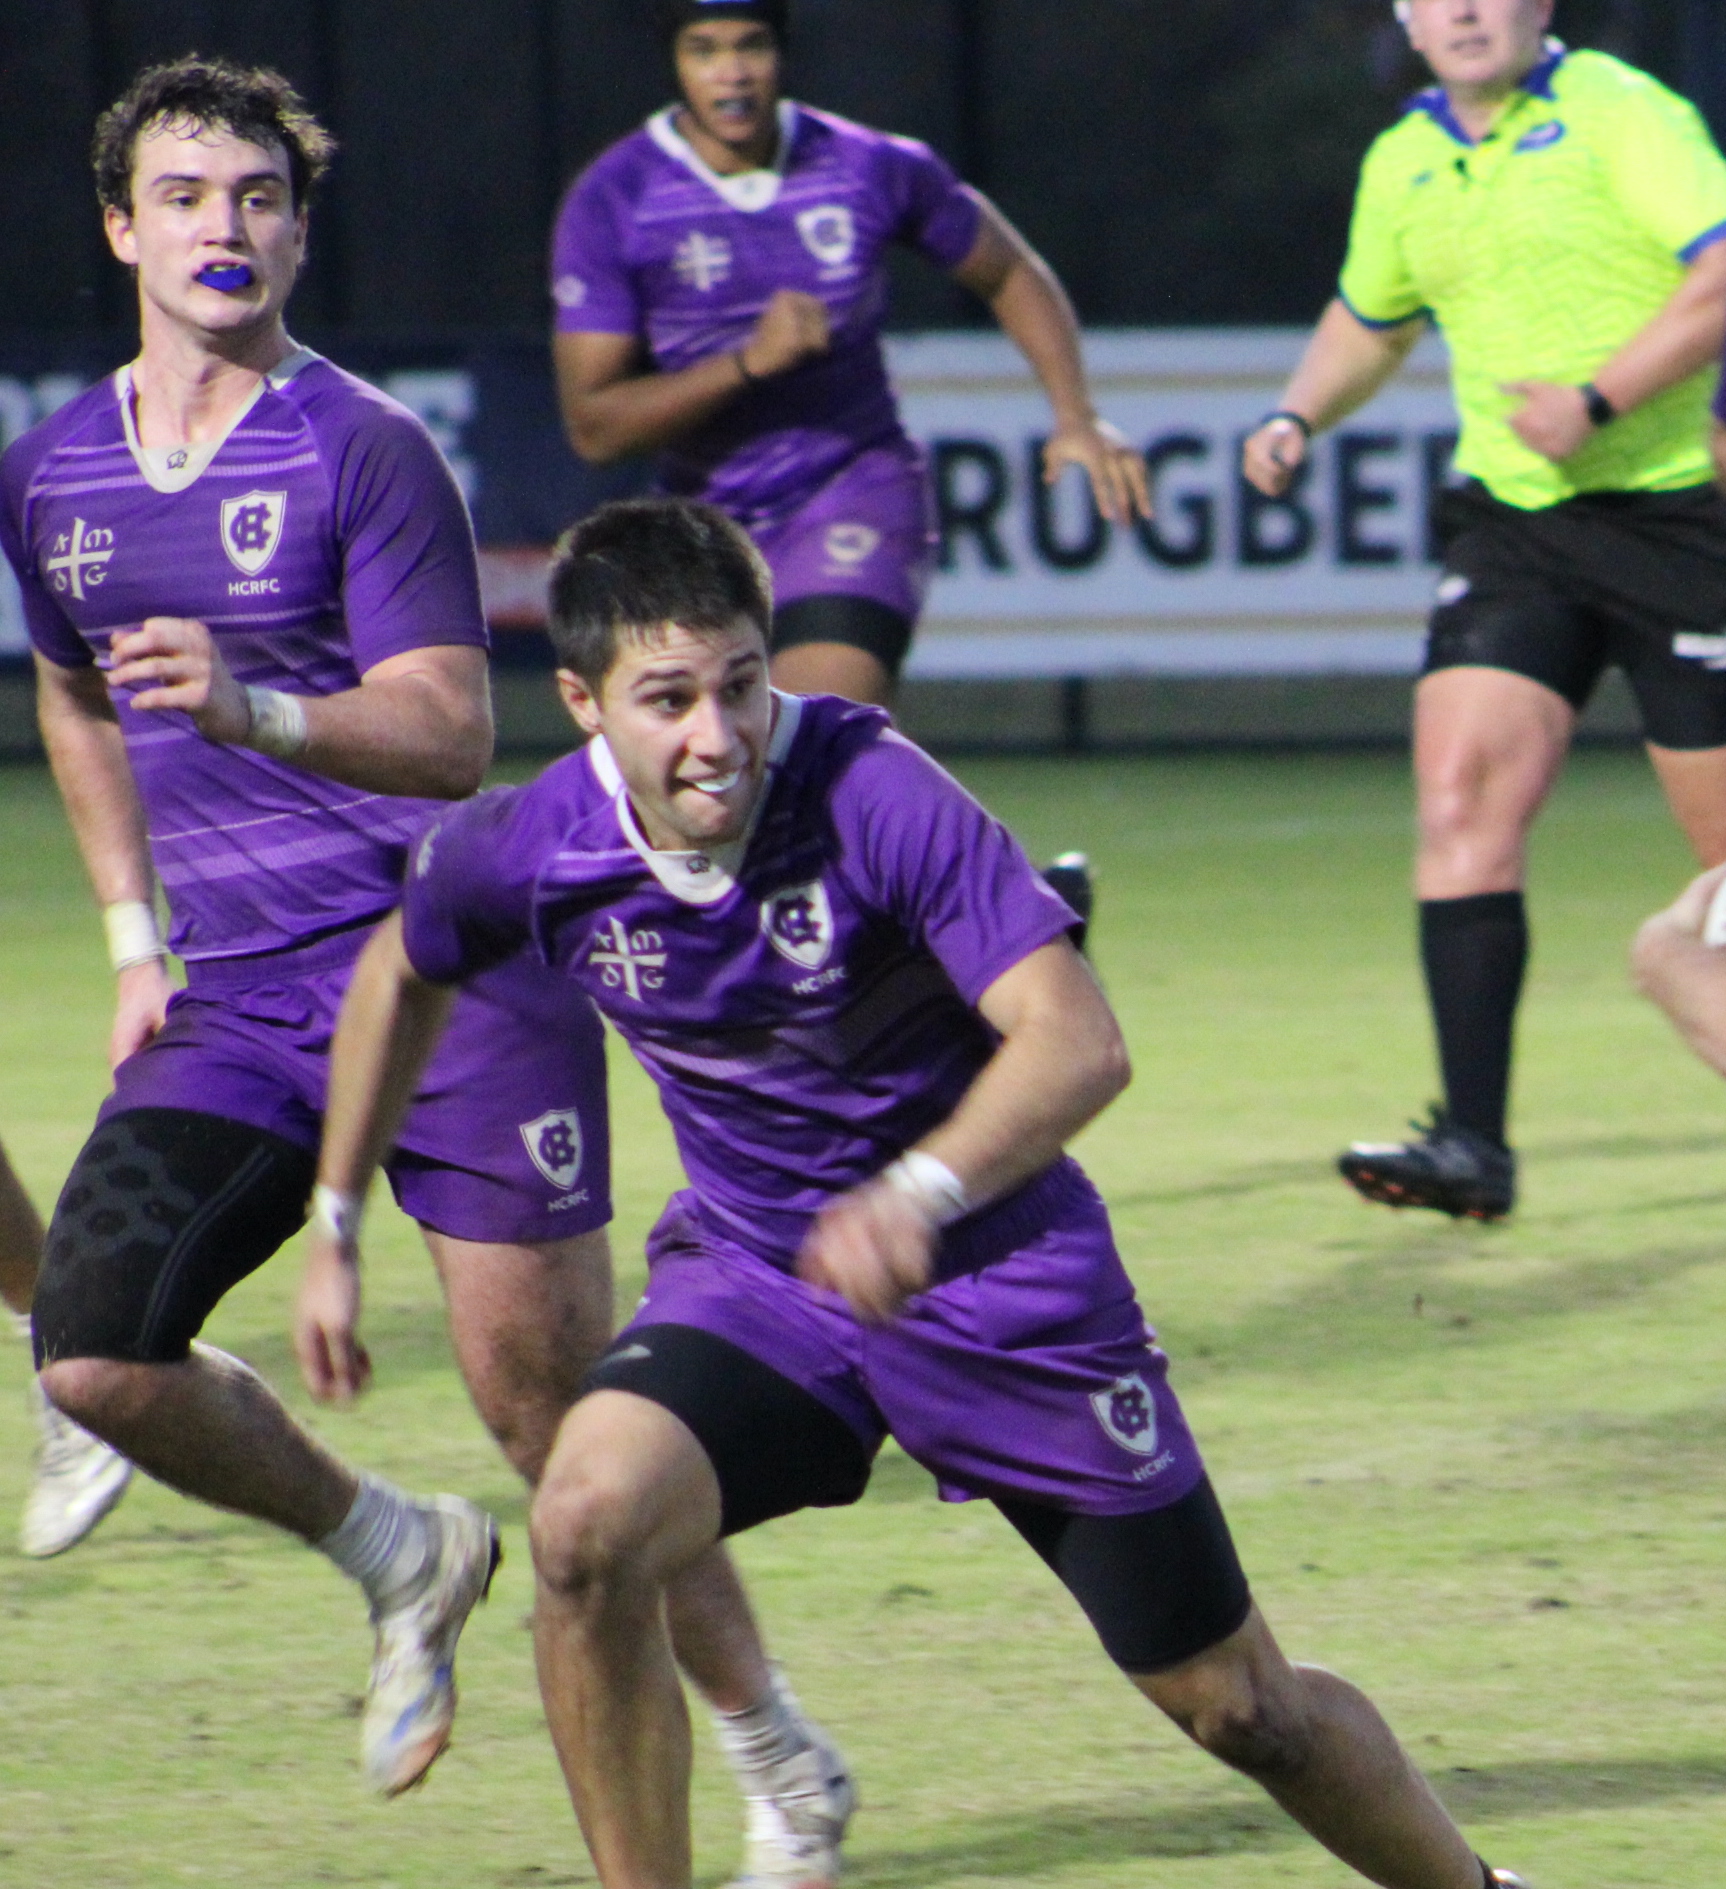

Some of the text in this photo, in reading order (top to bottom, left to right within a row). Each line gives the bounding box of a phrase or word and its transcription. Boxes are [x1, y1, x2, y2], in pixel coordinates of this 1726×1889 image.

[228, 578, 280, 596] HCRFC
[792, 966, 845, 994] HCRFC
[547, 1188, 590, 1213] HCRFC
